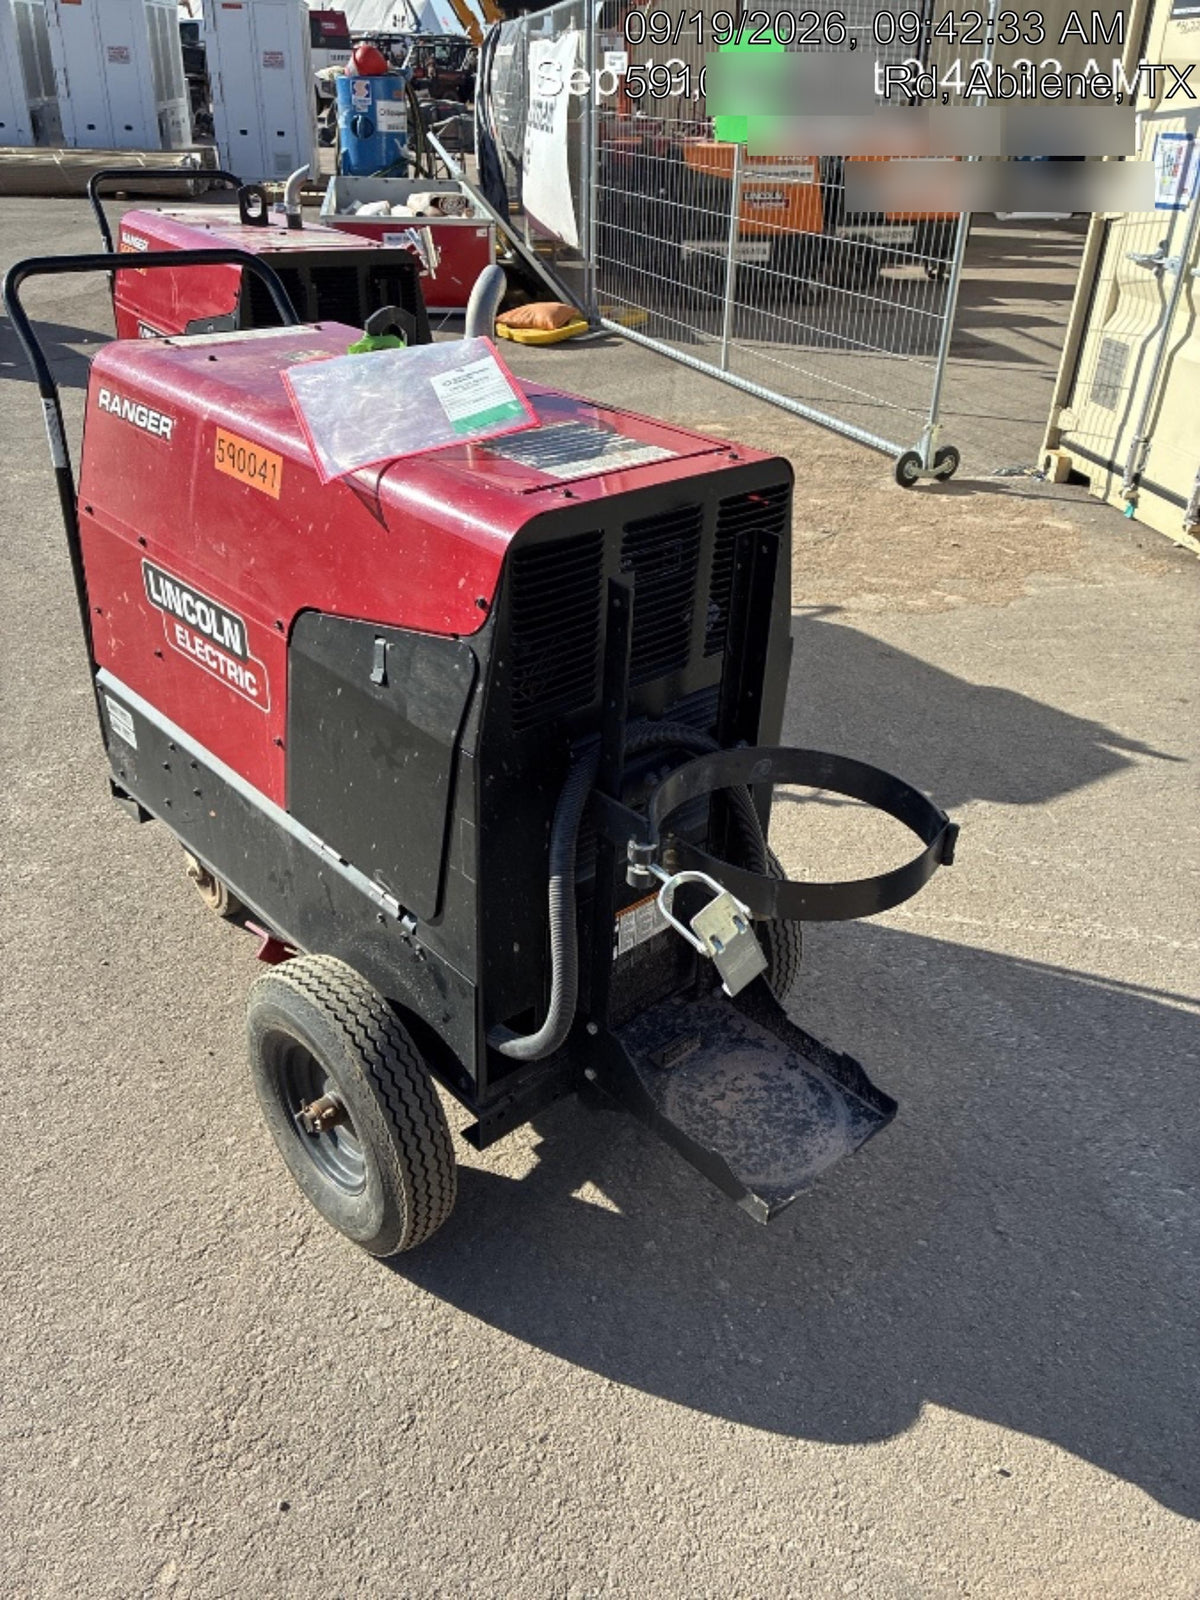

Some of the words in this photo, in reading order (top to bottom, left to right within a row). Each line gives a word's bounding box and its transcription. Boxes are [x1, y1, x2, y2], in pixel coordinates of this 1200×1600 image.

[98, 388, 173, 440] RANGER
[216, 438, 278, 488] 590041
[148, 570, 242, 655] LINCOLN
[174, 623, 259, 697] ELECTRIC
